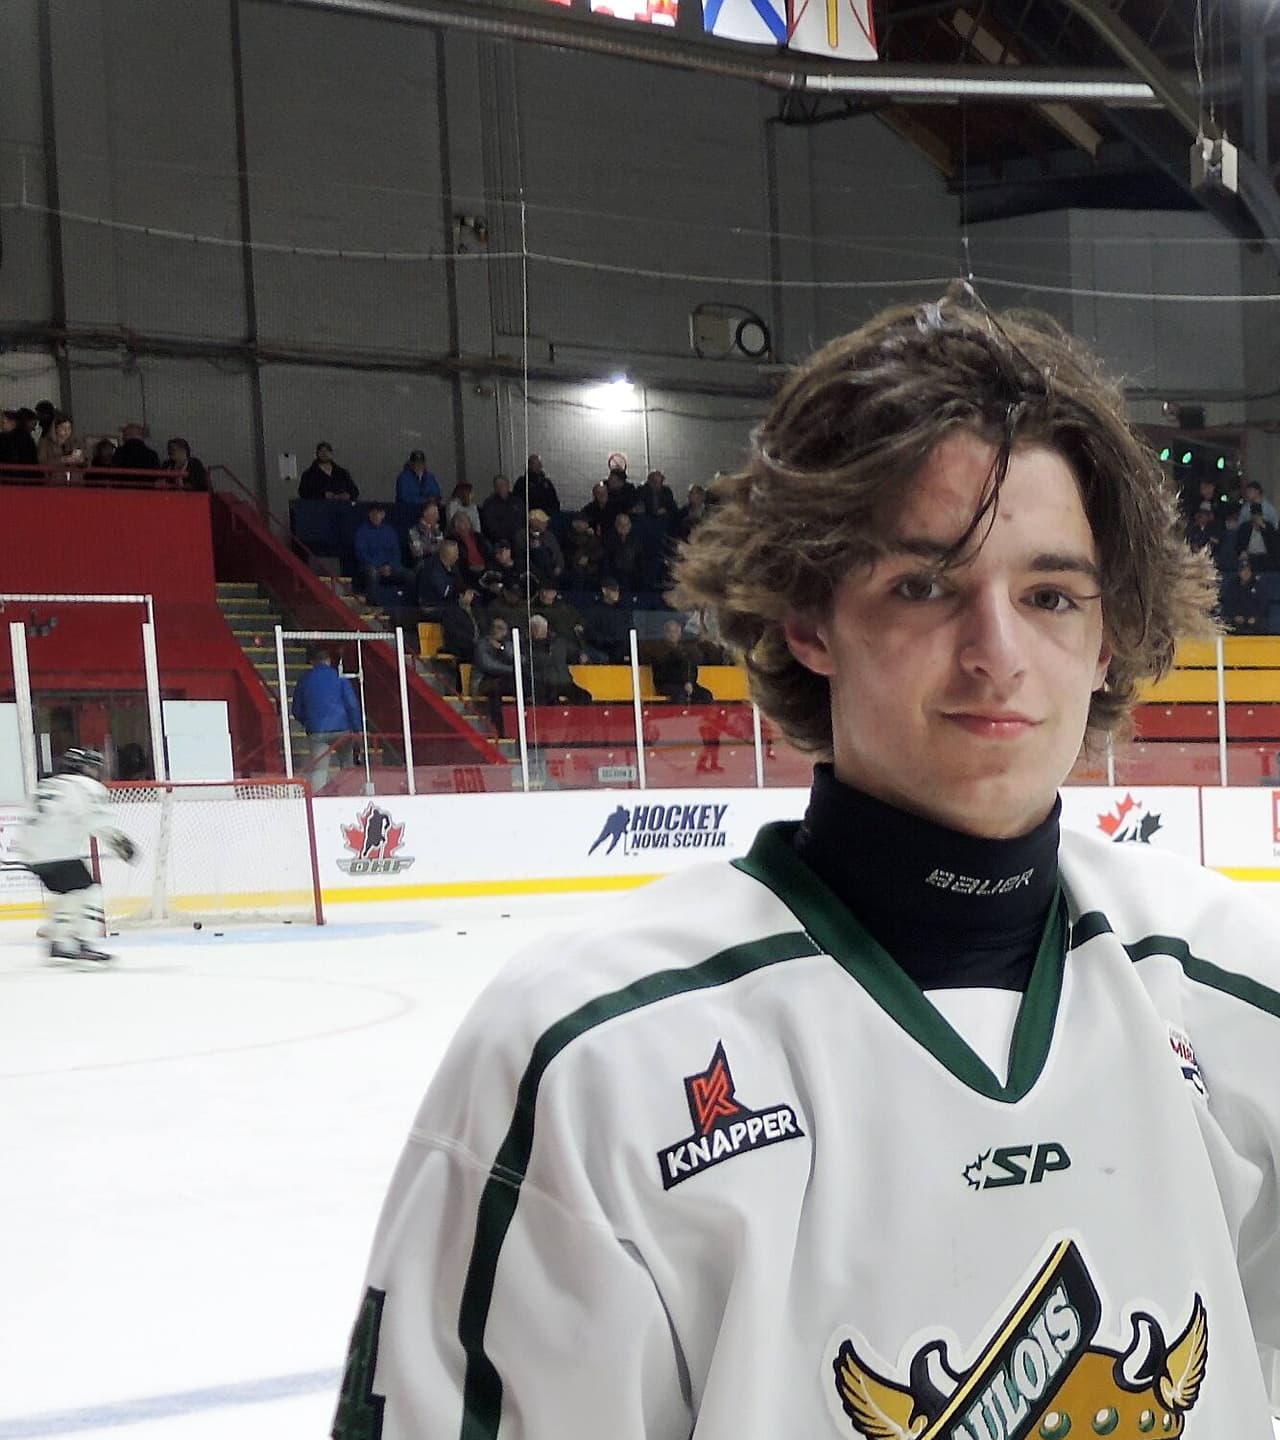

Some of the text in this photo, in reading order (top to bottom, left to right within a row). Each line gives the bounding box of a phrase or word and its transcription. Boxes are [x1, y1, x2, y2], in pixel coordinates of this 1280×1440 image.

[631, 804, 728, 832] HOCKEY
[631, 831, 726, 848] NOVA SCOTIA
[925, 868, 1035, 895] BAUER
[666, 1108, 797, 1178] KNAPPER
[983, 1142, 1071, 1189] SP
